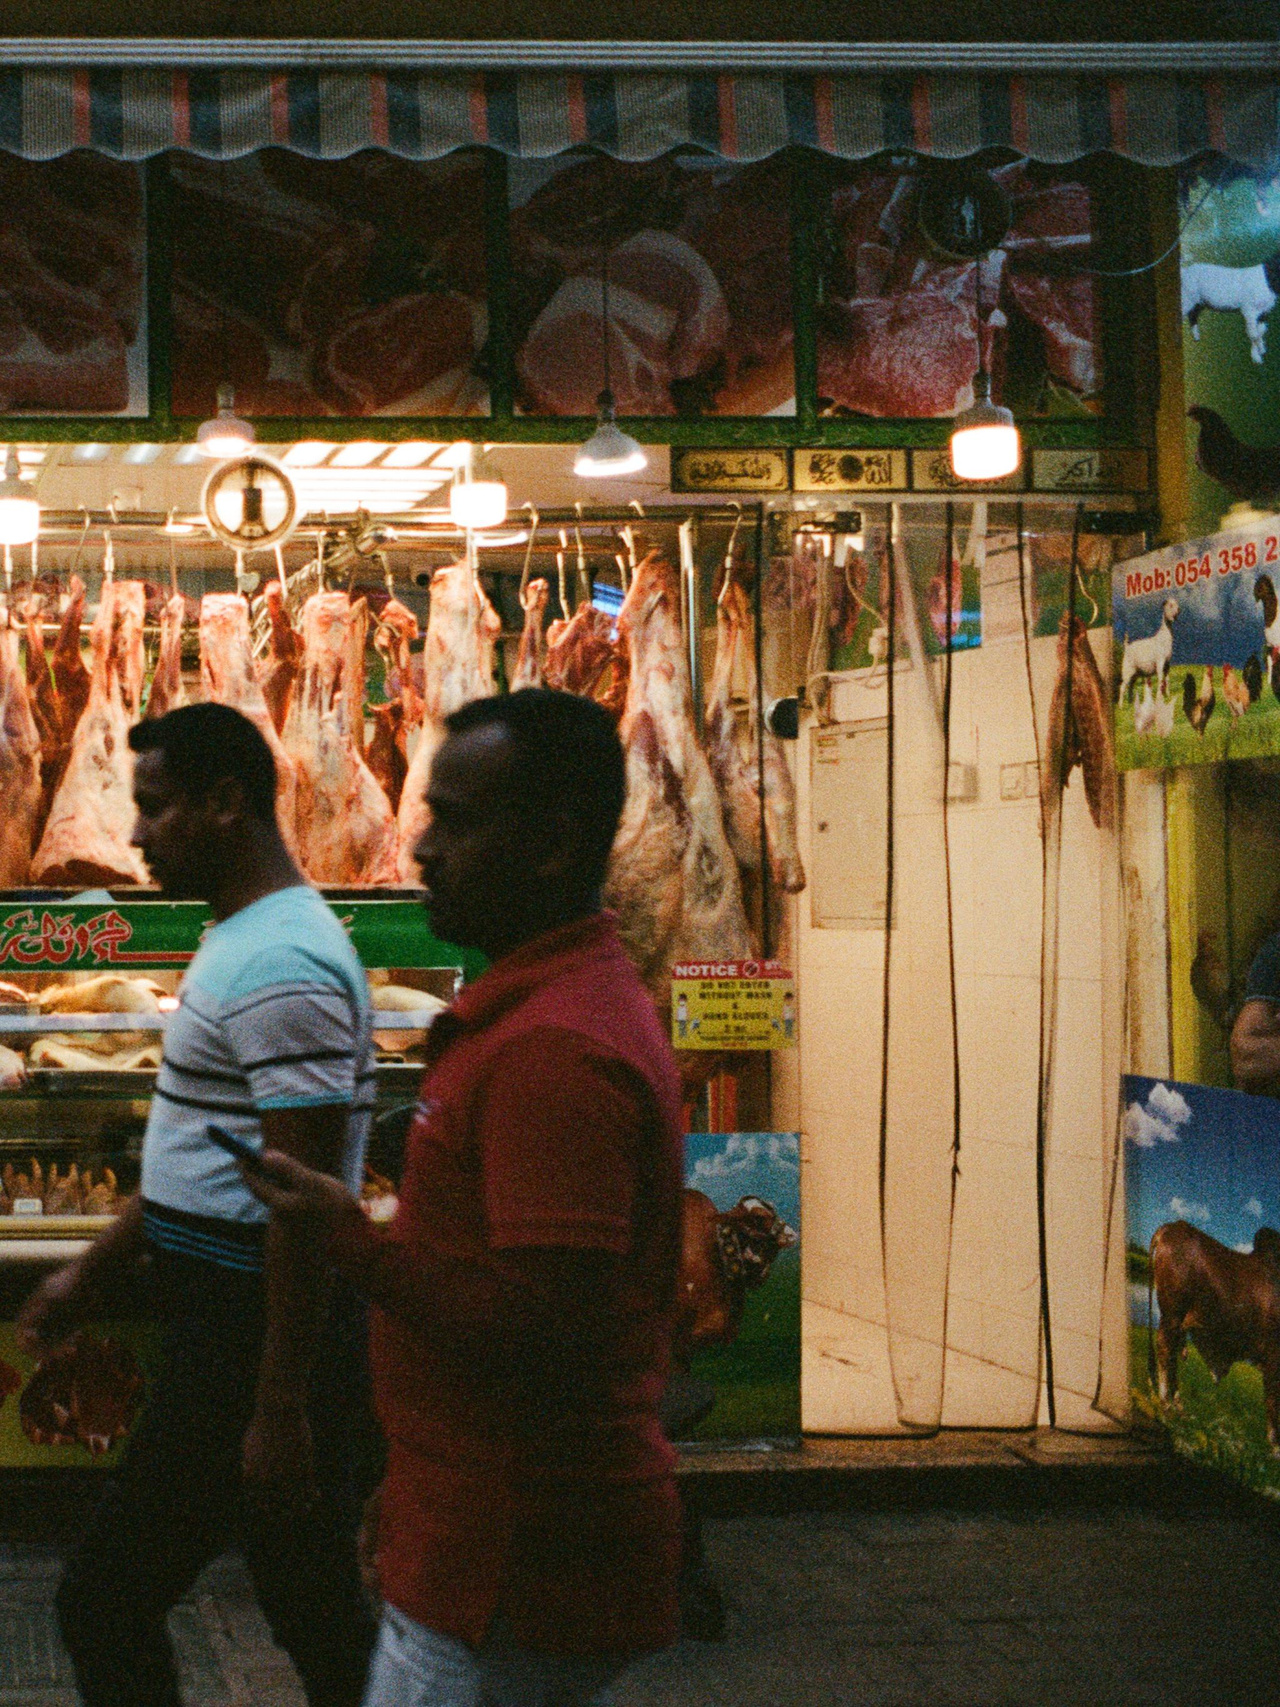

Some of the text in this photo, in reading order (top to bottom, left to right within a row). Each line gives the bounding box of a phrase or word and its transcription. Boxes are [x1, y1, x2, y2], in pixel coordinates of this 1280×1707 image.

[1125, 567, 1171, 598] Mob:
[1174, 553, 1212, 587] 054
[1218, 542, 1257, 575] 358
[675, 964, 738, 977] NOTICE
